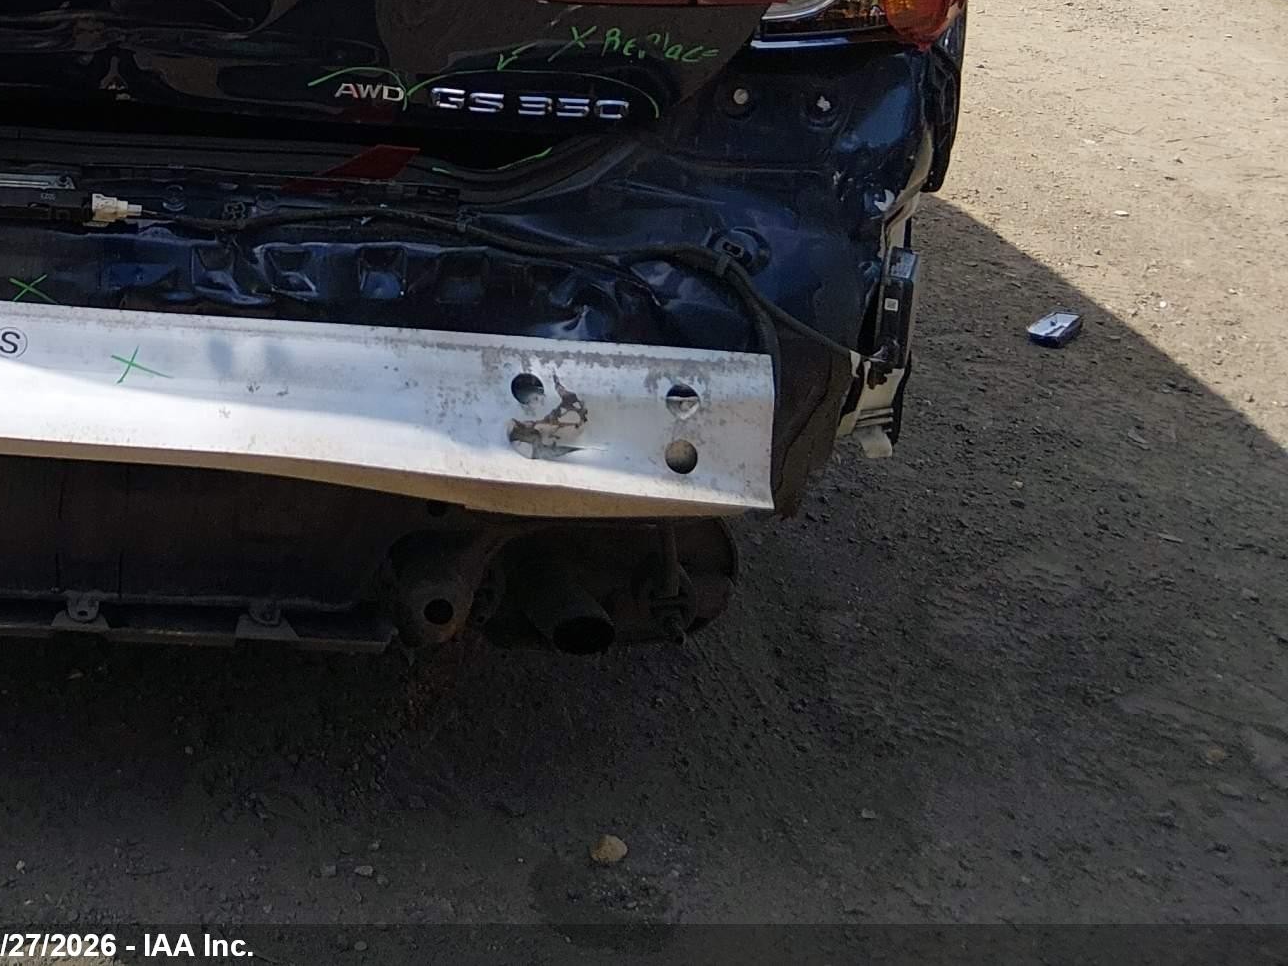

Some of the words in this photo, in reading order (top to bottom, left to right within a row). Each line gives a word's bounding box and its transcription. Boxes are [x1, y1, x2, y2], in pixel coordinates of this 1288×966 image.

[334, 82, 404, 102] AWD
[431, 86, 505, 114] GS
[518, 94, 630, 120] 350
